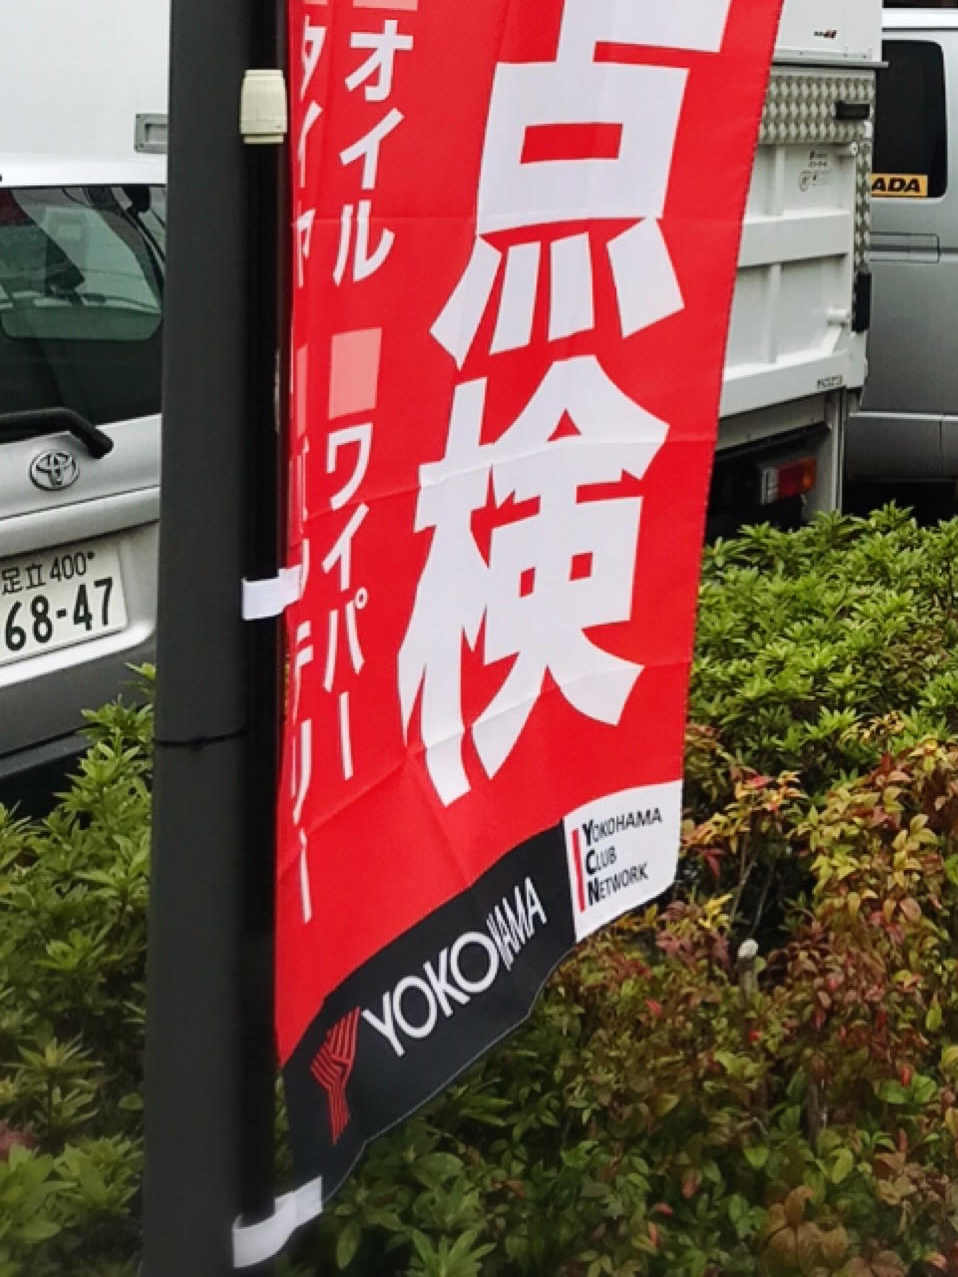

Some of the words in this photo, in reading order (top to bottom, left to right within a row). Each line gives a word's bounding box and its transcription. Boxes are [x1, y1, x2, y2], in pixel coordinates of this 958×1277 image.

[333, 19, 414, 287] オイル
[1, 564, 46, 595] 足立
[49, 552, 87, 583] 400
[5, 576, 113, 652] 68-47
[322, 423, 374, 781] ワイパー
[582, 807, 663, 847] YOKOHAMA
[585, 845, 617, 875] CLUB
[587, 861, 649, 907] NETWORK
